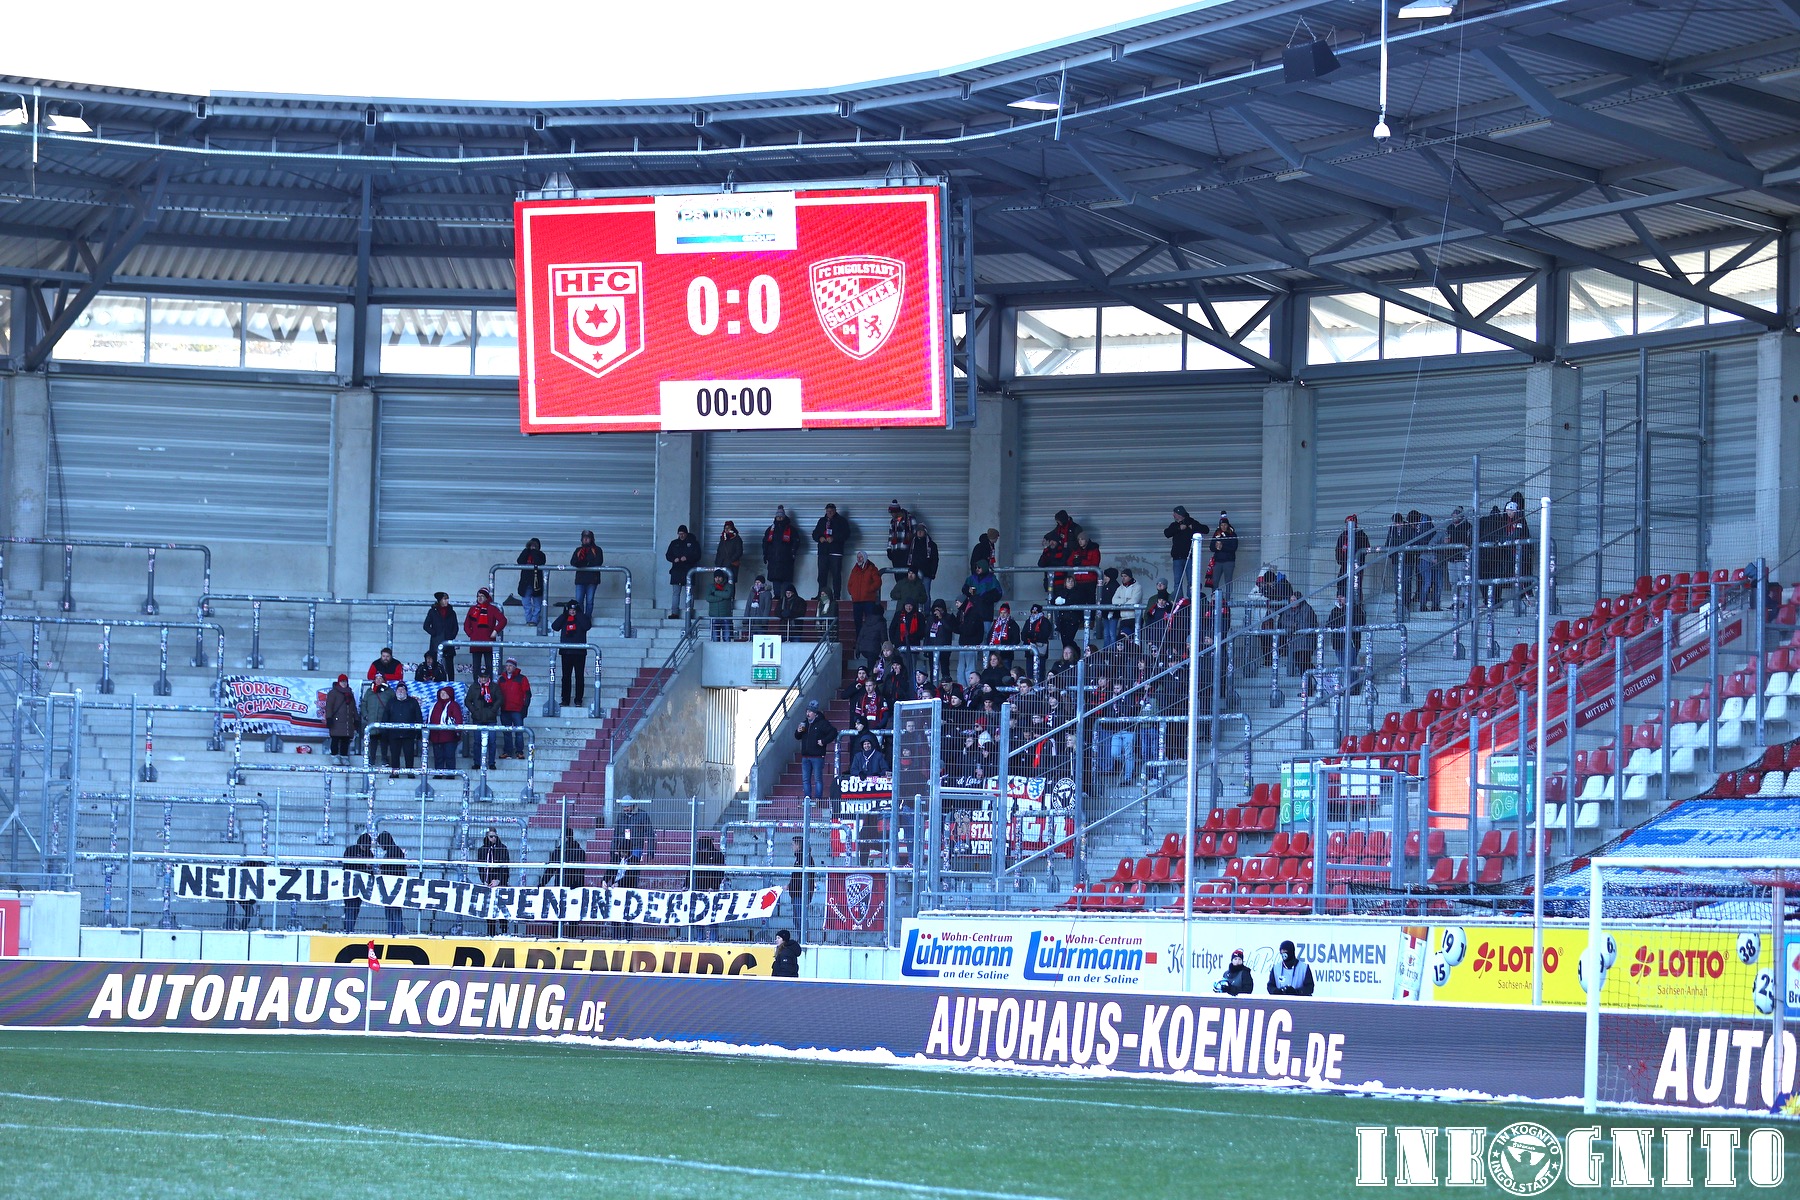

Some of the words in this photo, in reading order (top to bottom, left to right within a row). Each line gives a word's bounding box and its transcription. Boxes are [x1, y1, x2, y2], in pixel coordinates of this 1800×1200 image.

[560, 272, 630, 292] HFC
[686, 274, 781, 336] 0:0
[696, 387, 772, 416] 00:00
[759, 642, 774, 659] 11
[230, 682, 291, 698] TORKEL
[1584, 700, 1610, 720] MITTEN
[1622, 674, 1656, 698] PORTLEBEN
[236, 698, 308, 717] SCHANZER
[178, 864, 264, 900] NEIN
[276, 868, 328, 900] ZU
[342, 869, 567, 919] INVESTOREN
[580, 888, 612, 921] IN
[942, 932, 1012, 943] Wohn-Centrum
[1065, 934, 1142, 946] Wohn-Centrum
[902, 928, 1014, 978] Lührmann
[1023, 930, 1143, 982] Lührmann
[1296, 943, 1386, 965] ZUSAMMEN
[1498, 946, 1559, 974] LOTO
[1739, 938, 1756, 963] 38
[1434, 964, 1446, 982] 15
[1658, 950, 1724, 978] LOTTO
[943, 970, 957, 978] an
[958, 970, 975, 979] der
[977, 970, 1010, 980] Saline
[1083, 974, 1102, 984] der
[1104, 974, 1139, 985] Saline
[1315, 970, 1350, 983] WIRD'S
[1353, 970, 1382, 984] EDEL.
[1657, 986, 1708, 996] Sachsen-Anhalt
